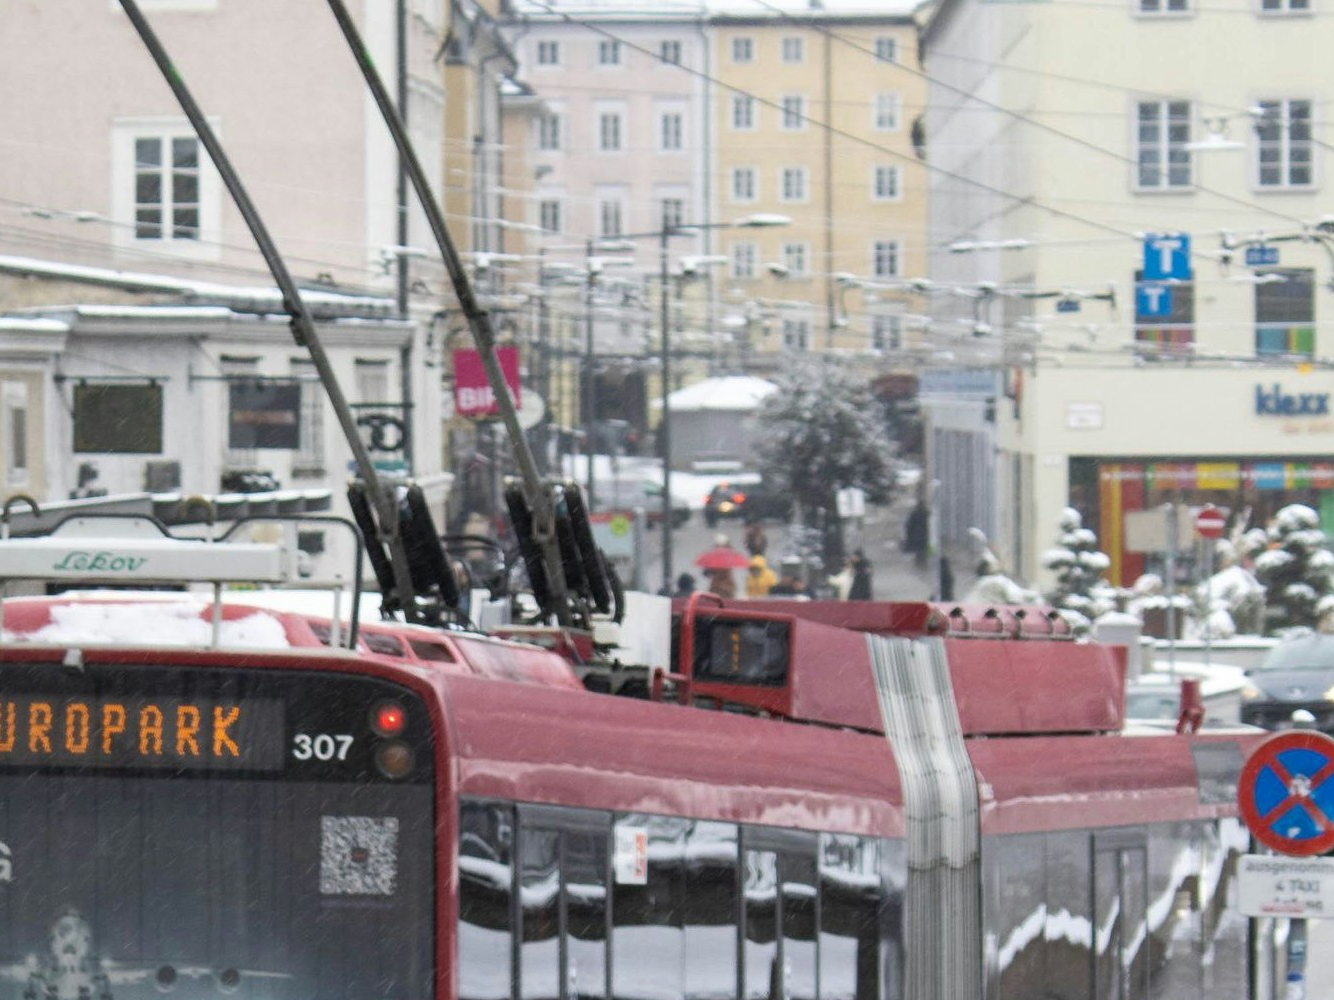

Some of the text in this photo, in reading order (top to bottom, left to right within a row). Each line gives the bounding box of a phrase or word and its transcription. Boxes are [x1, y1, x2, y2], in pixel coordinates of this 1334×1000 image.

[458, 386, 497, 410] BIP
[1255, 383, 1330, 415] klexx
[52, 550, 150, 572] Lekov
[292, 734, 355, 761] 307
